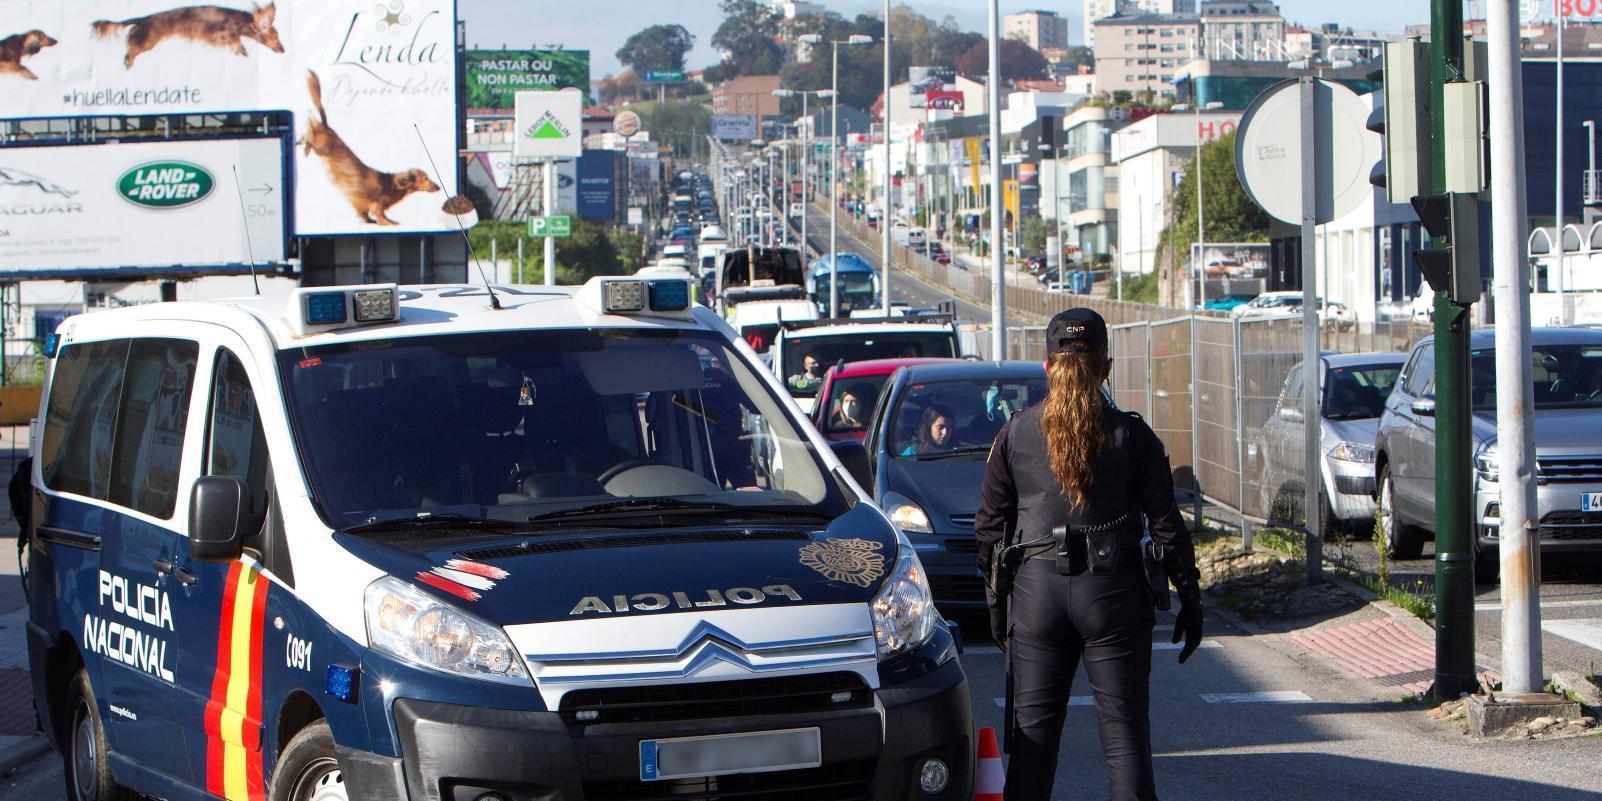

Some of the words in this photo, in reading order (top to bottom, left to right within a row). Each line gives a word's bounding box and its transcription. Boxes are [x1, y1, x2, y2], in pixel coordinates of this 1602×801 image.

[330, 10, 440, 70] Lenda
[481, 60, 530, 71] PASTAR
[531, 60, 553, 71] OU
[477, 74, 507, 85] NON
[509, 74, 557, 85] PASTAR
[64, 86, 202, 107] #huellaLendate
[524, 116, 547, 138] LEROY
[134, 168, 185, 185] LAND
[138, 183, 200, 200] ROVER
[532, 218, 546, 235] P
[99, 569, 175, 632] POLICÍA
[84, 613, 175, 683] NACIONAL
[645, 764, 653, 774] E
